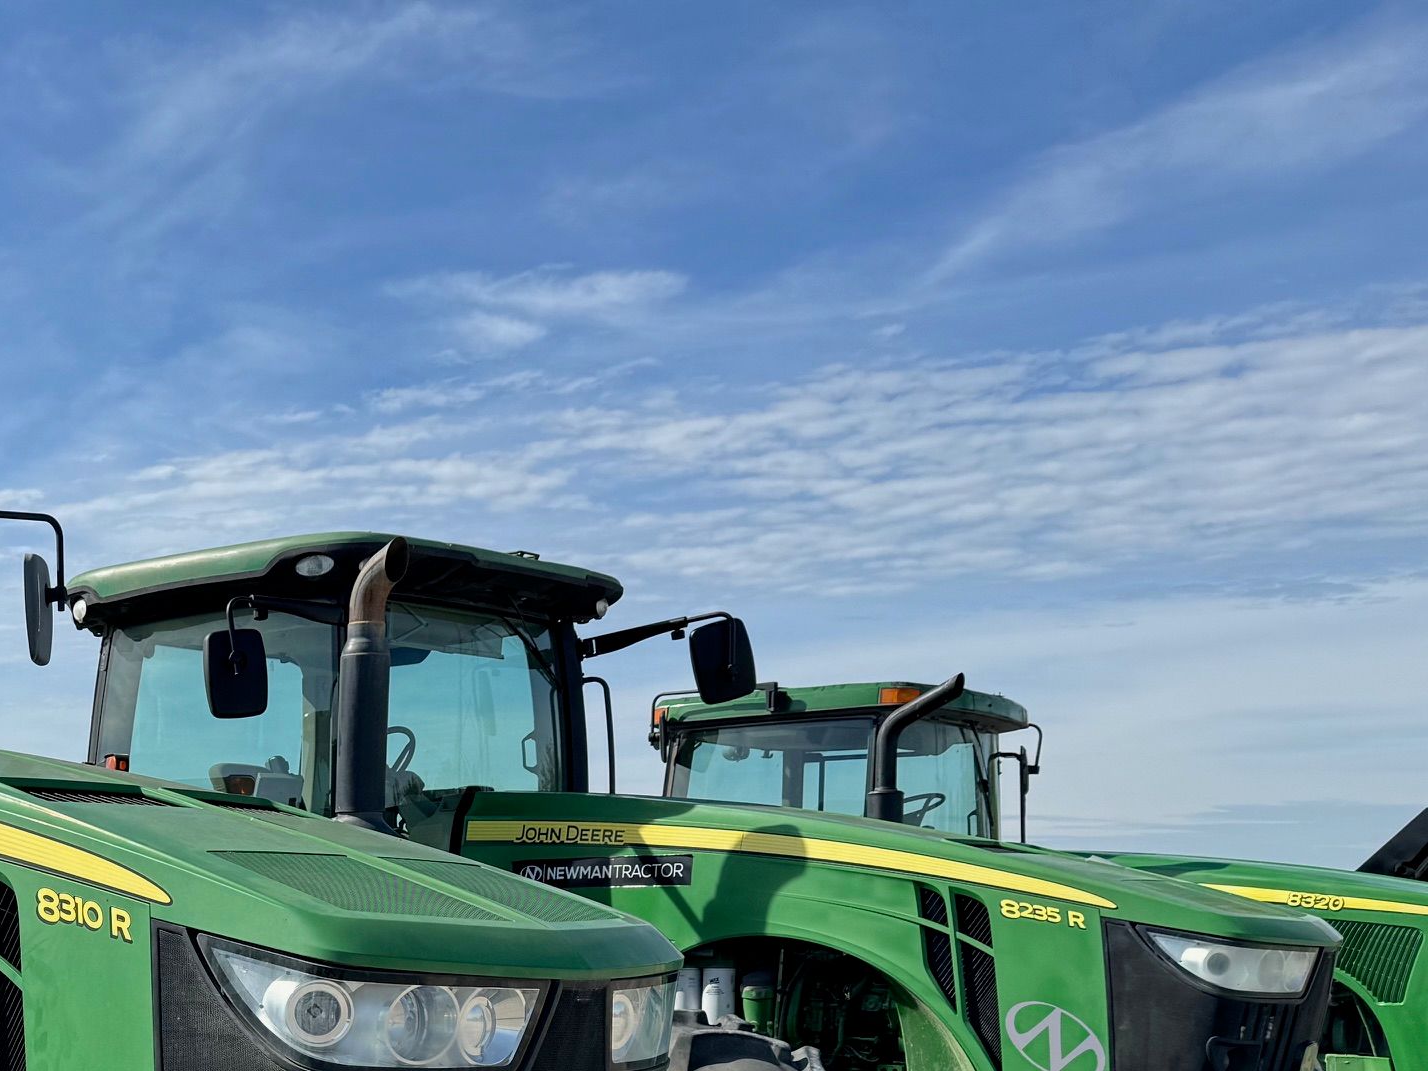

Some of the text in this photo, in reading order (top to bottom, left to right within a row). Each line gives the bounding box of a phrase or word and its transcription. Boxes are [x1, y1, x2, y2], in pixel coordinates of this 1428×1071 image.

[516, 824, 625, 844] JOHN DEERE
[546, 862, 684, 881] NEWMANTRACTOR
[1287, 892, 1345, 912] 8320
[36, 887, 133, 944] 8310 R
[1000, 899, 1087, 930] 8235 R
